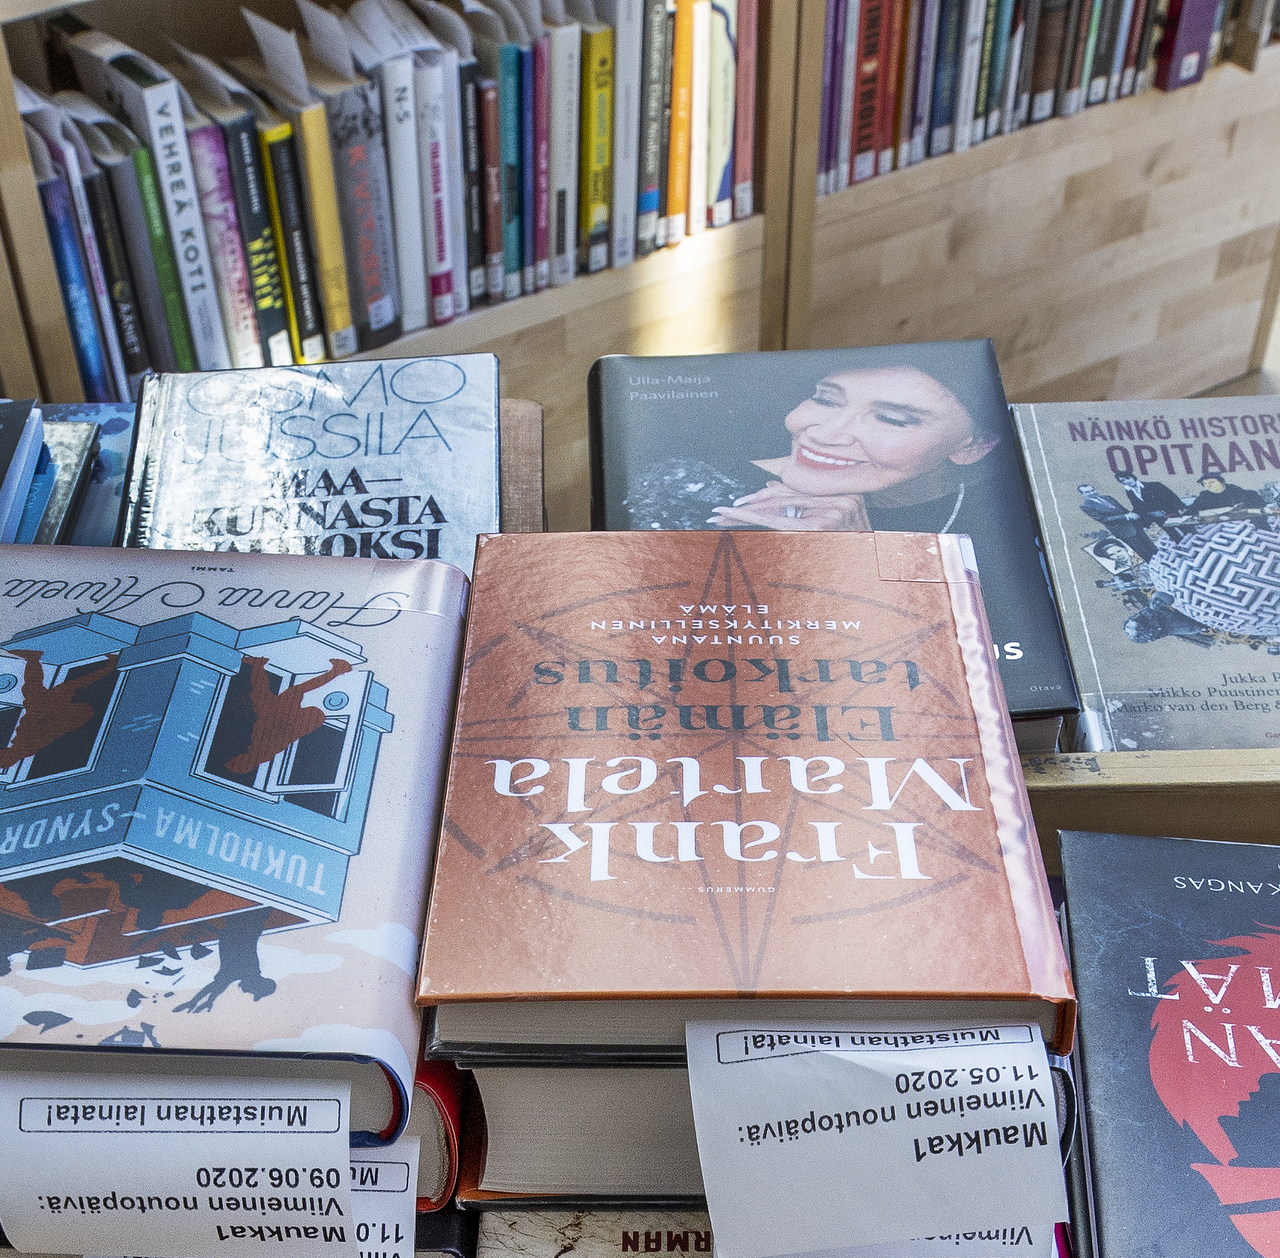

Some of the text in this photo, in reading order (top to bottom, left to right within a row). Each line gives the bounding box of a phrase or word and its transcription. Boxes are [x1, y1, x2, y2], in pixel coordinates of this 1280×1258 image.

[152, 100, 207, 294] VEHREÄ KOTI
[187, 359, 466, 416] OSMO
[629, 375, 711, 385] Ulla-Maija
[630, 390, 718, 400] Paavilainen
[182, 409, 452, 464] JUSSILA
[1067, 414, 1173, 443] NÄINKÖ
[192, 495, 448, 537] KUNNASTA
[190, 565, 234, 574] TAMMI
[1, 578, 409, 628] Hanna Arvela
[678, 603, 769, 618] ELÄMÄ
[590, 618, 860, 631] MERKITYKSELLINEN
[652, 633, 801, 646] SUUNTANA
[533, 658, 920, 694] tarkoitus
[1221, 672, 1264, 686] Jukka
[1030, 684, 1062, 693] Otava
[1149, 686, 1202, 700] Mikko
[1168, 703, 1197, 713] van
[1200, 700, 1229, 713] den
[1233, 699, 1272, 715] Berg
[564, 704, 899, 742] Elämän
[484, 755, 982, 813] Martela
[538, 819, 931, 882] Frank
[696, 884, 775, 893] GUMMERUS
[742, 1029, 1000, 1055] Muistathan lainata!
[894, 1064, 1039, 1094] 11.05.2020
[46, 1104, 308, 1126] Muistathan lainata!
[738, 1088, 1045, 1144] Viimeinen noutopäivä:
[912, 1121, 1047, 1162] Maukka1
[196, 1167, 341, 1188] 09.06.2020
[38, 1192, 344, 1216] Viimeinen noutopäivä:
[215, 1225, 345, 1242] Maukka1
